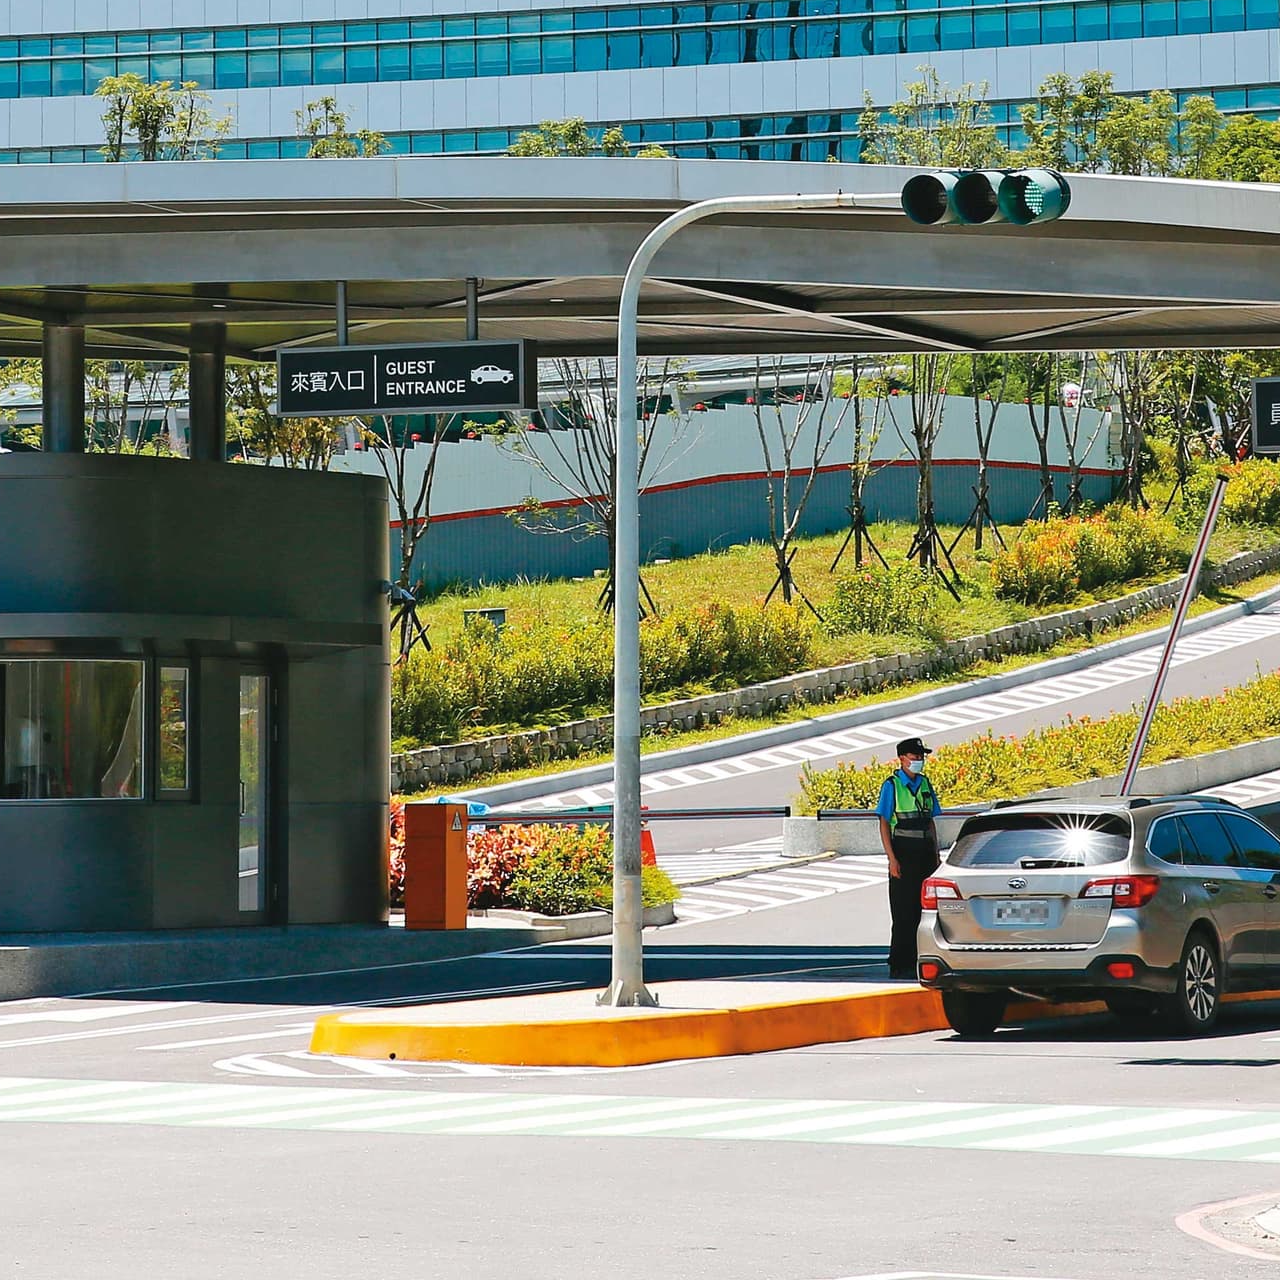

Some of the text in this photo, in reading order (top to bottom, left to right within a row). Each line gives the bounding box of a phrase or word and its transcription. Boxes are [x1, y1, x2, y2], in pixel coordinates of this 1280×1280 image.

[386, 360, 436, 375] GUEST
[291, 370, 365, 393] 來賓入口
[386, 380, 466, 396] ENTRANCE
